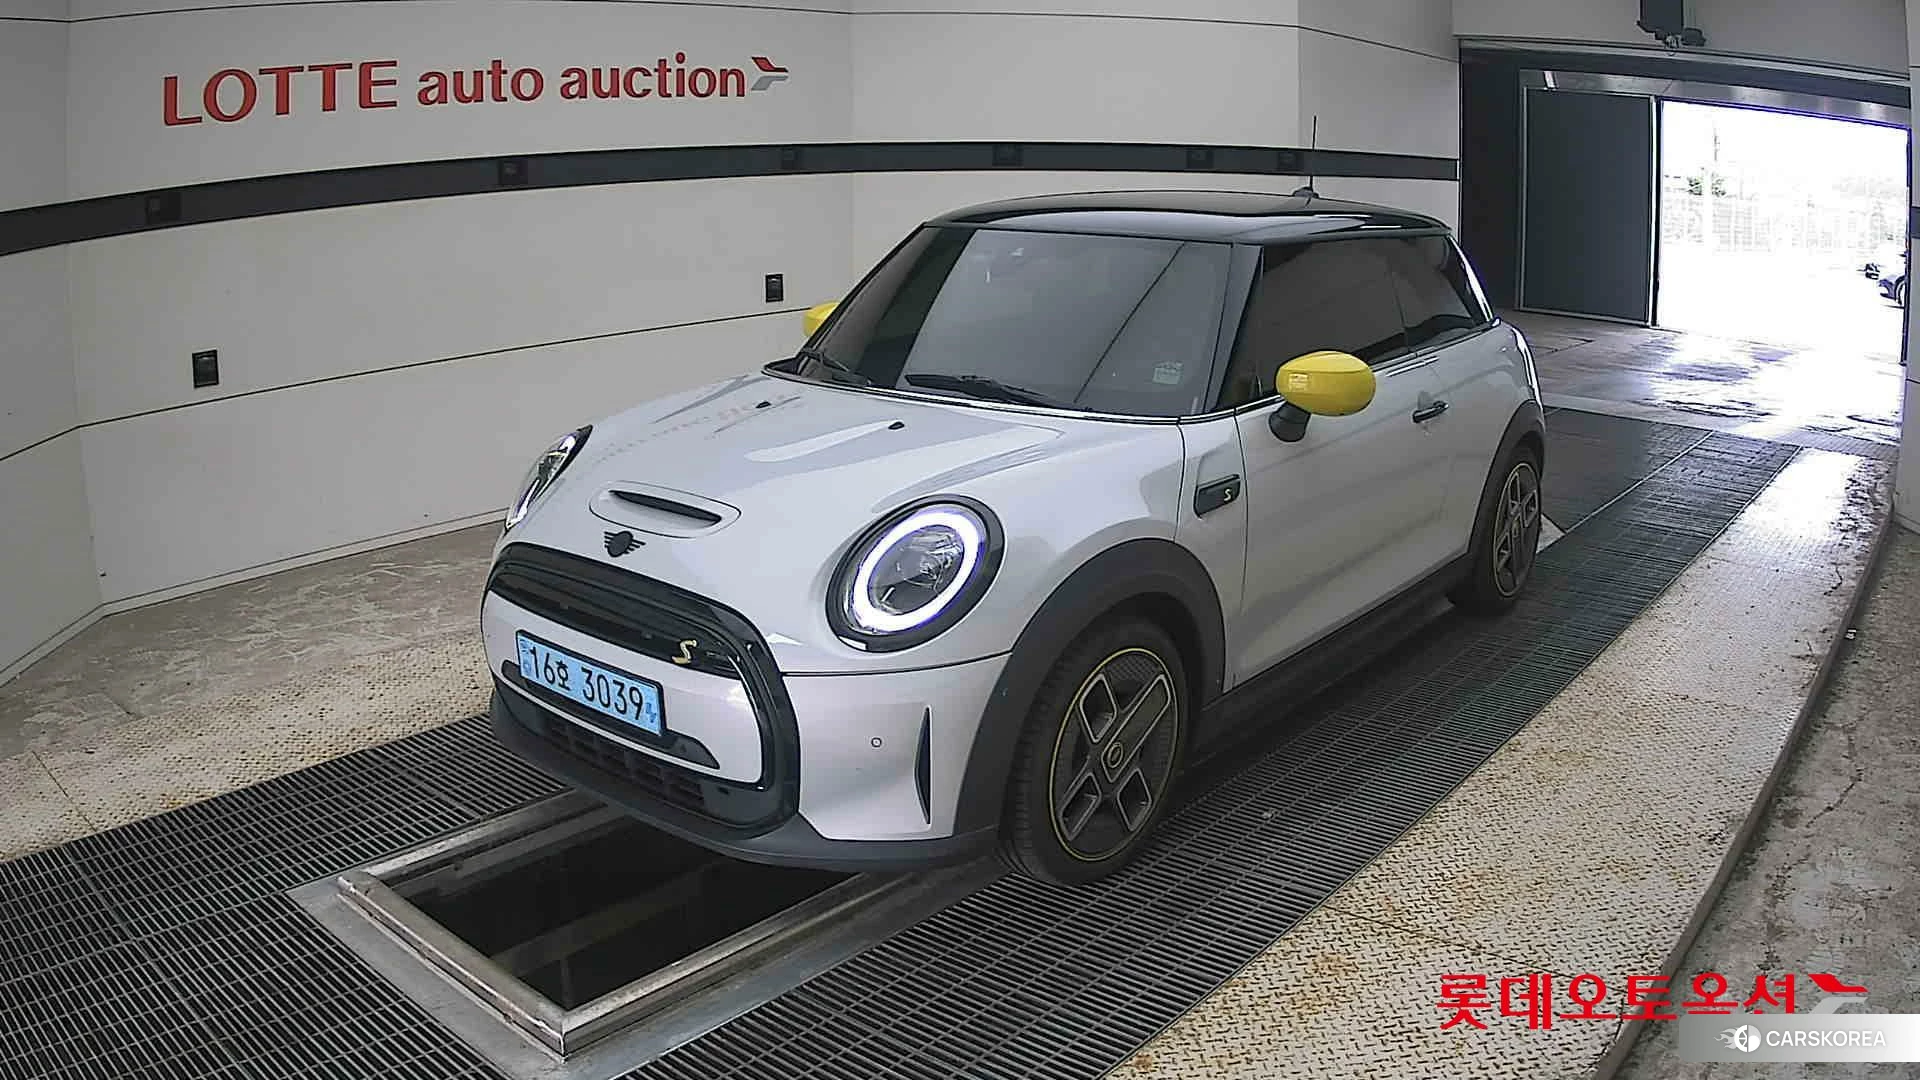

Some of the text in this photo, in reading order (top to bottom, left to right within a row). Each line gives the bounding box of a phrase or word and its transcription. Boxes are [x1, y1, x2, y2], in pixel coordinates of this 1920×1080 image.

[163, 53, 747, 126] LOTTE auto auction
[1223, 489, 1232, 501] S
[672, 639, 697, 664] S
[529, 646, 643, 720] 16호 3039
